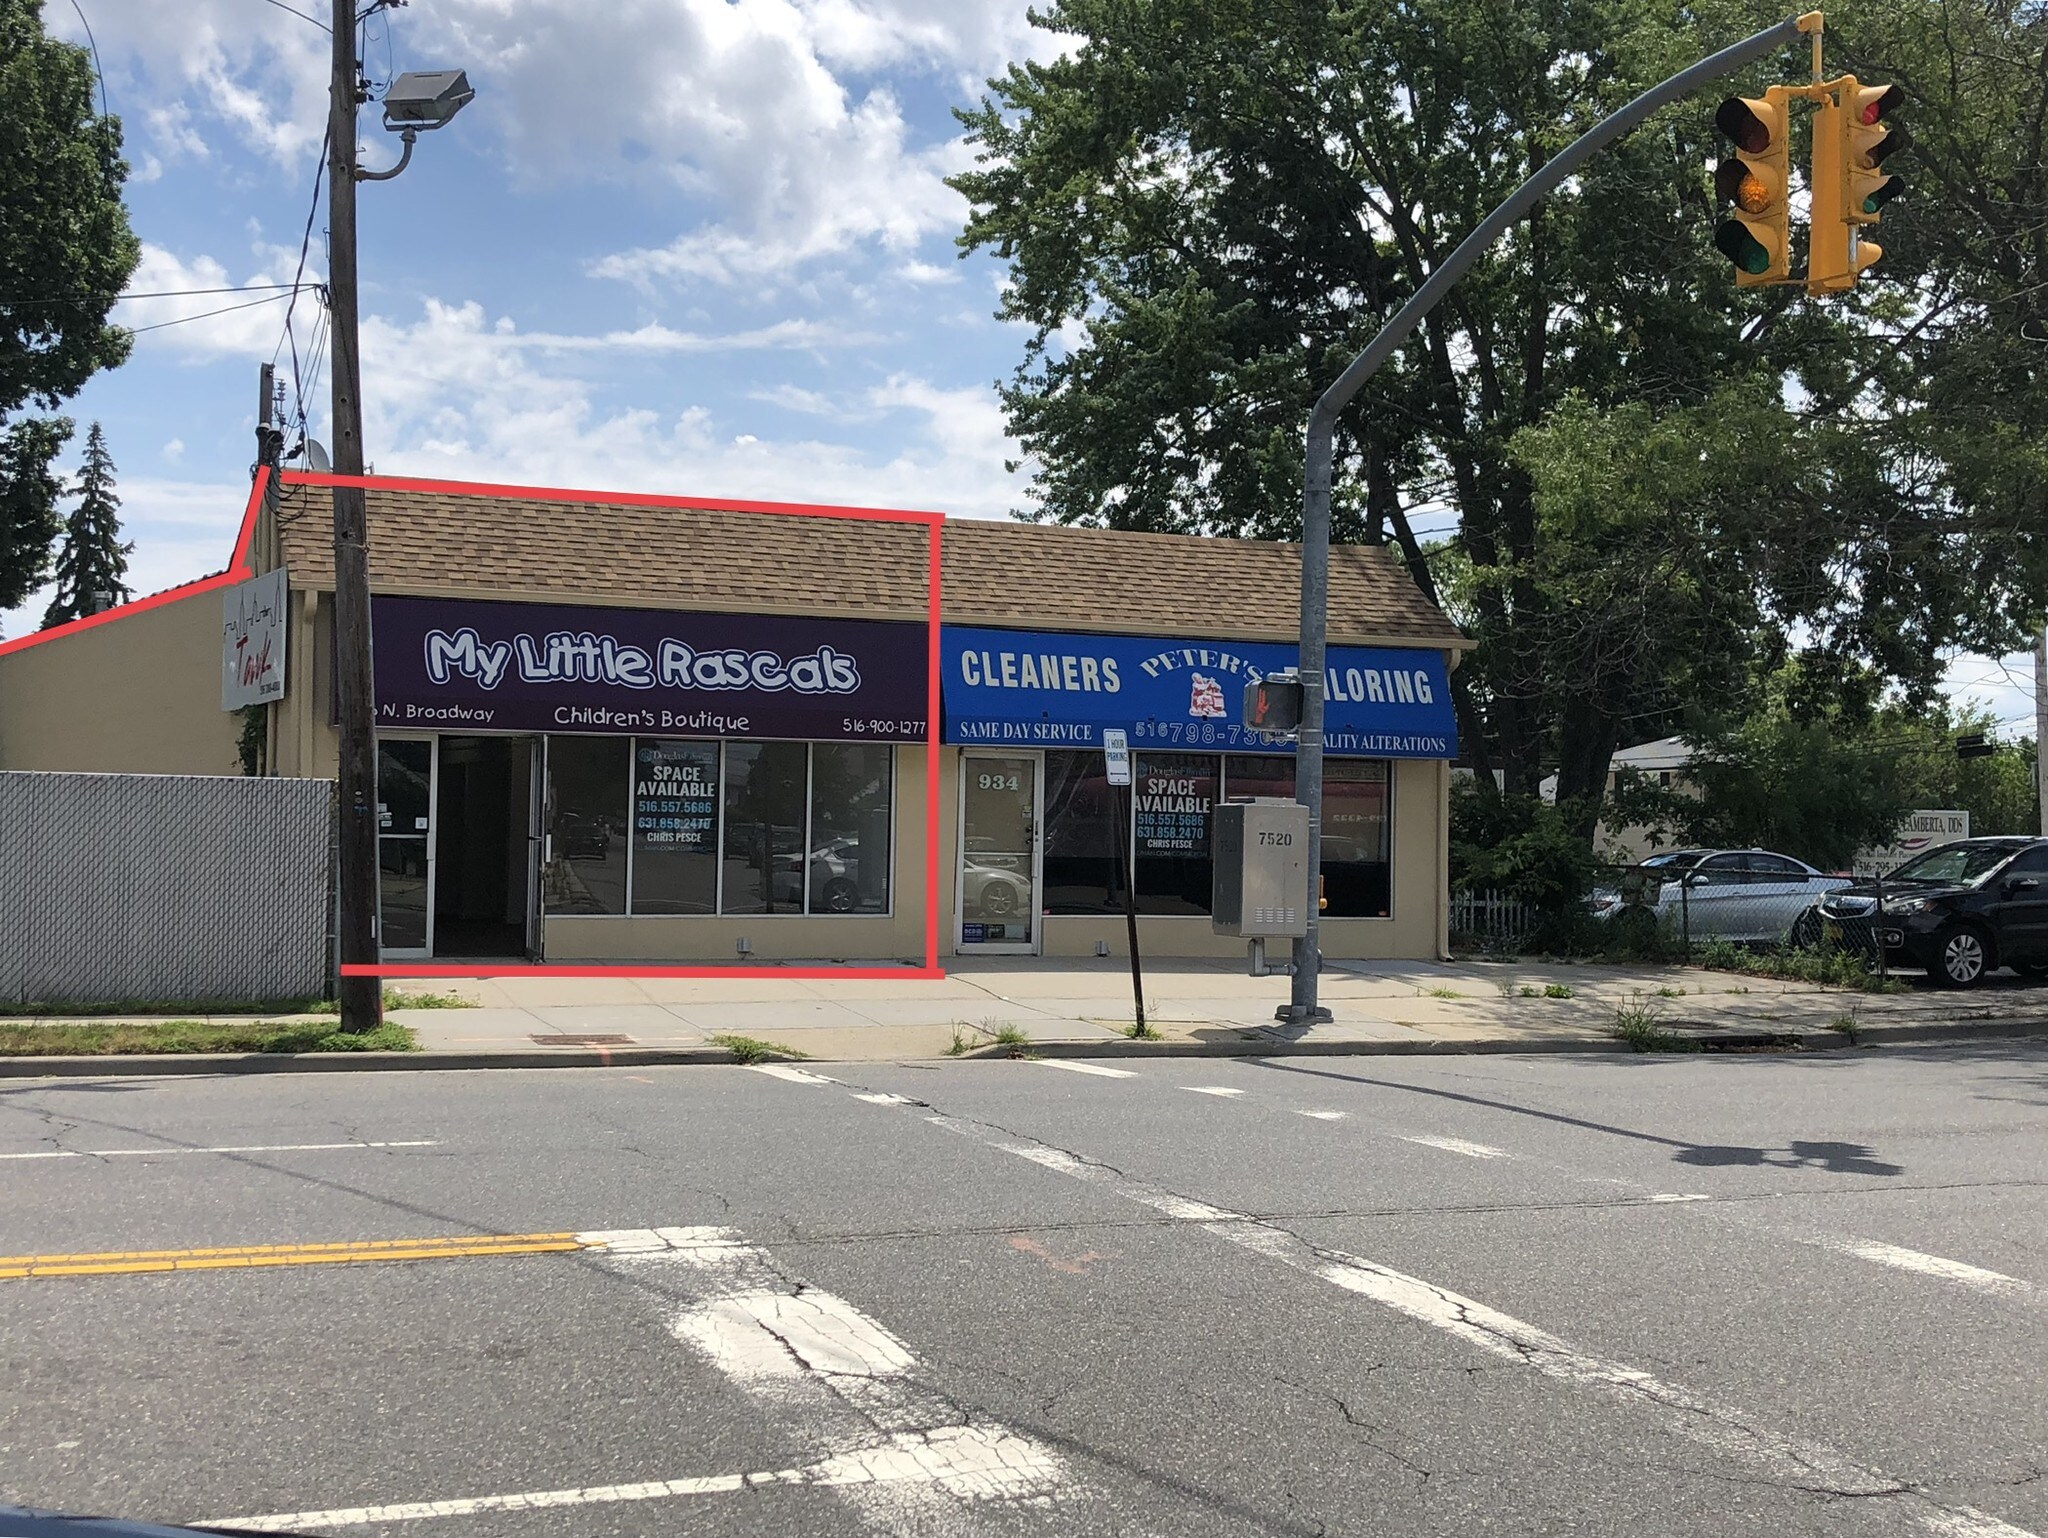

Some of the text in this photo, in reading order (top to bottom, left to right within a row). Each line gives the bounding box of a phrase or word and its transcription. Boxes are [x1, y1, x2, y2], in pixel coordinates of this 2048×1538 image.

[424, 627, 861, 694] My Little Rascals
[1139, 649, 1264, 681] PETER'S
[961, 650, 1121, 693] CLEANERS
[1283, 666, 1434, 705] ILORING
[383, 702, 400, 718] N.
[406, 704, 495, 723] Broadway
[554, 706, 750, 733] Children's Boutique
[843, 718, 927, 735] 516-900-1277
[960, 721, 1093, 741] SAME DAY SERVICE
[1111, 739, 1124, 749] HOUR
[1322, 734, 1447, 752] ALITY ALTERATIONS
[1107, 752, 1127, 762] PARKING
[653, 766, 701, 781] SPACE
[637, 781, 715, 797] AVAILABLE
[979, 774, 1019, 791] 934
[1148, 778, 1196, 795] SPACE
[638, 801, 713, 813] 516.557.5686
[1134, 795, 1211, 813] AVAILABLE
[638, 817, 712, 830] 631.858.2470
[1137, 813, 1204, 826] 516.557.5686
[1949, 817, 1963, 833] DDS
[647, 832, 702, 842] CHRIS PESCE
[1136, 826, 1204, 839] 631.858.2470
[1259, 832, 1292, 846] 7520
[1147, 839, 1193, 849] CHRIS PESCE
